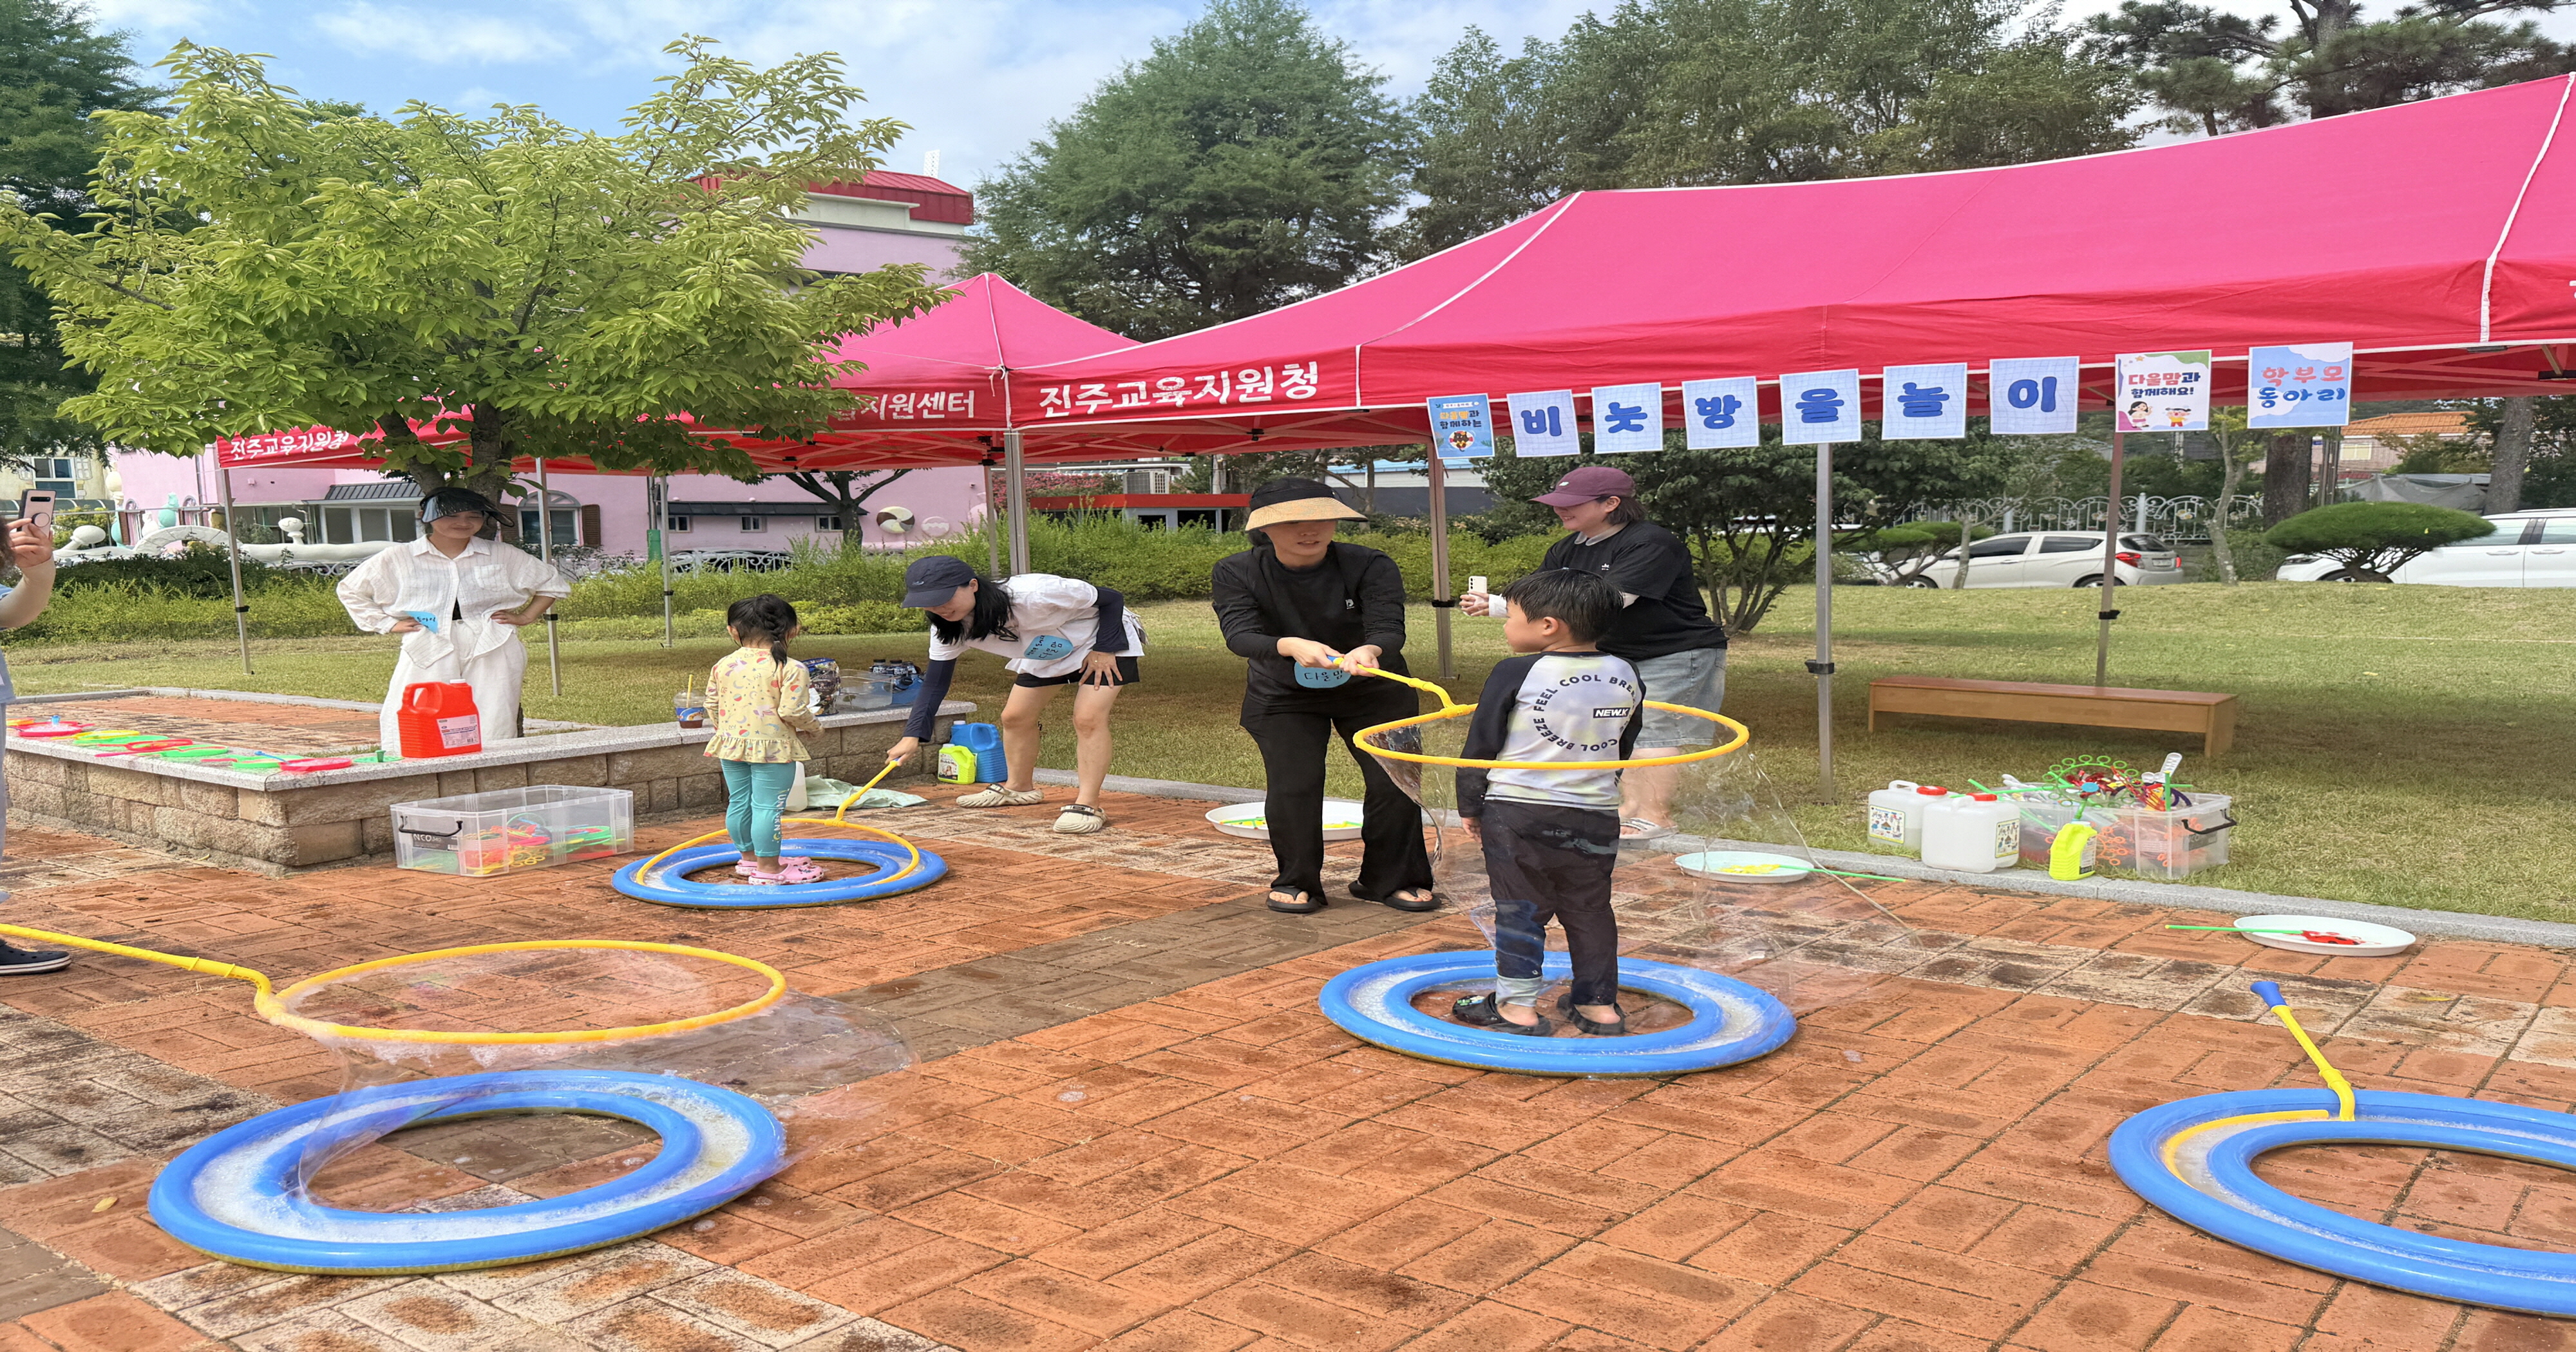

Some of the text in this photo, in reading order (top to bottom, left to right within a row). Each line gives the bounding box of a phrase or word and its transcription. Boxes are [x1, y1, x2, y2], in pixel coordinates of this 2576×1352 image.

[2261, 366, 2345, 387] 학부모
[1039, 361, 1318, 418] 진주교육지원청
[2130, 387, 2194, 398] 함께해요!
[2257, 386, 2345, 408] 동아리
[1439, 420, 1482, 429] 함께하는
[1533, 688, 1558, 711] FEEL
[1559, 675, 1601, 686] COOL
[1533, 718, 1618, 751] COOL BREEZE
